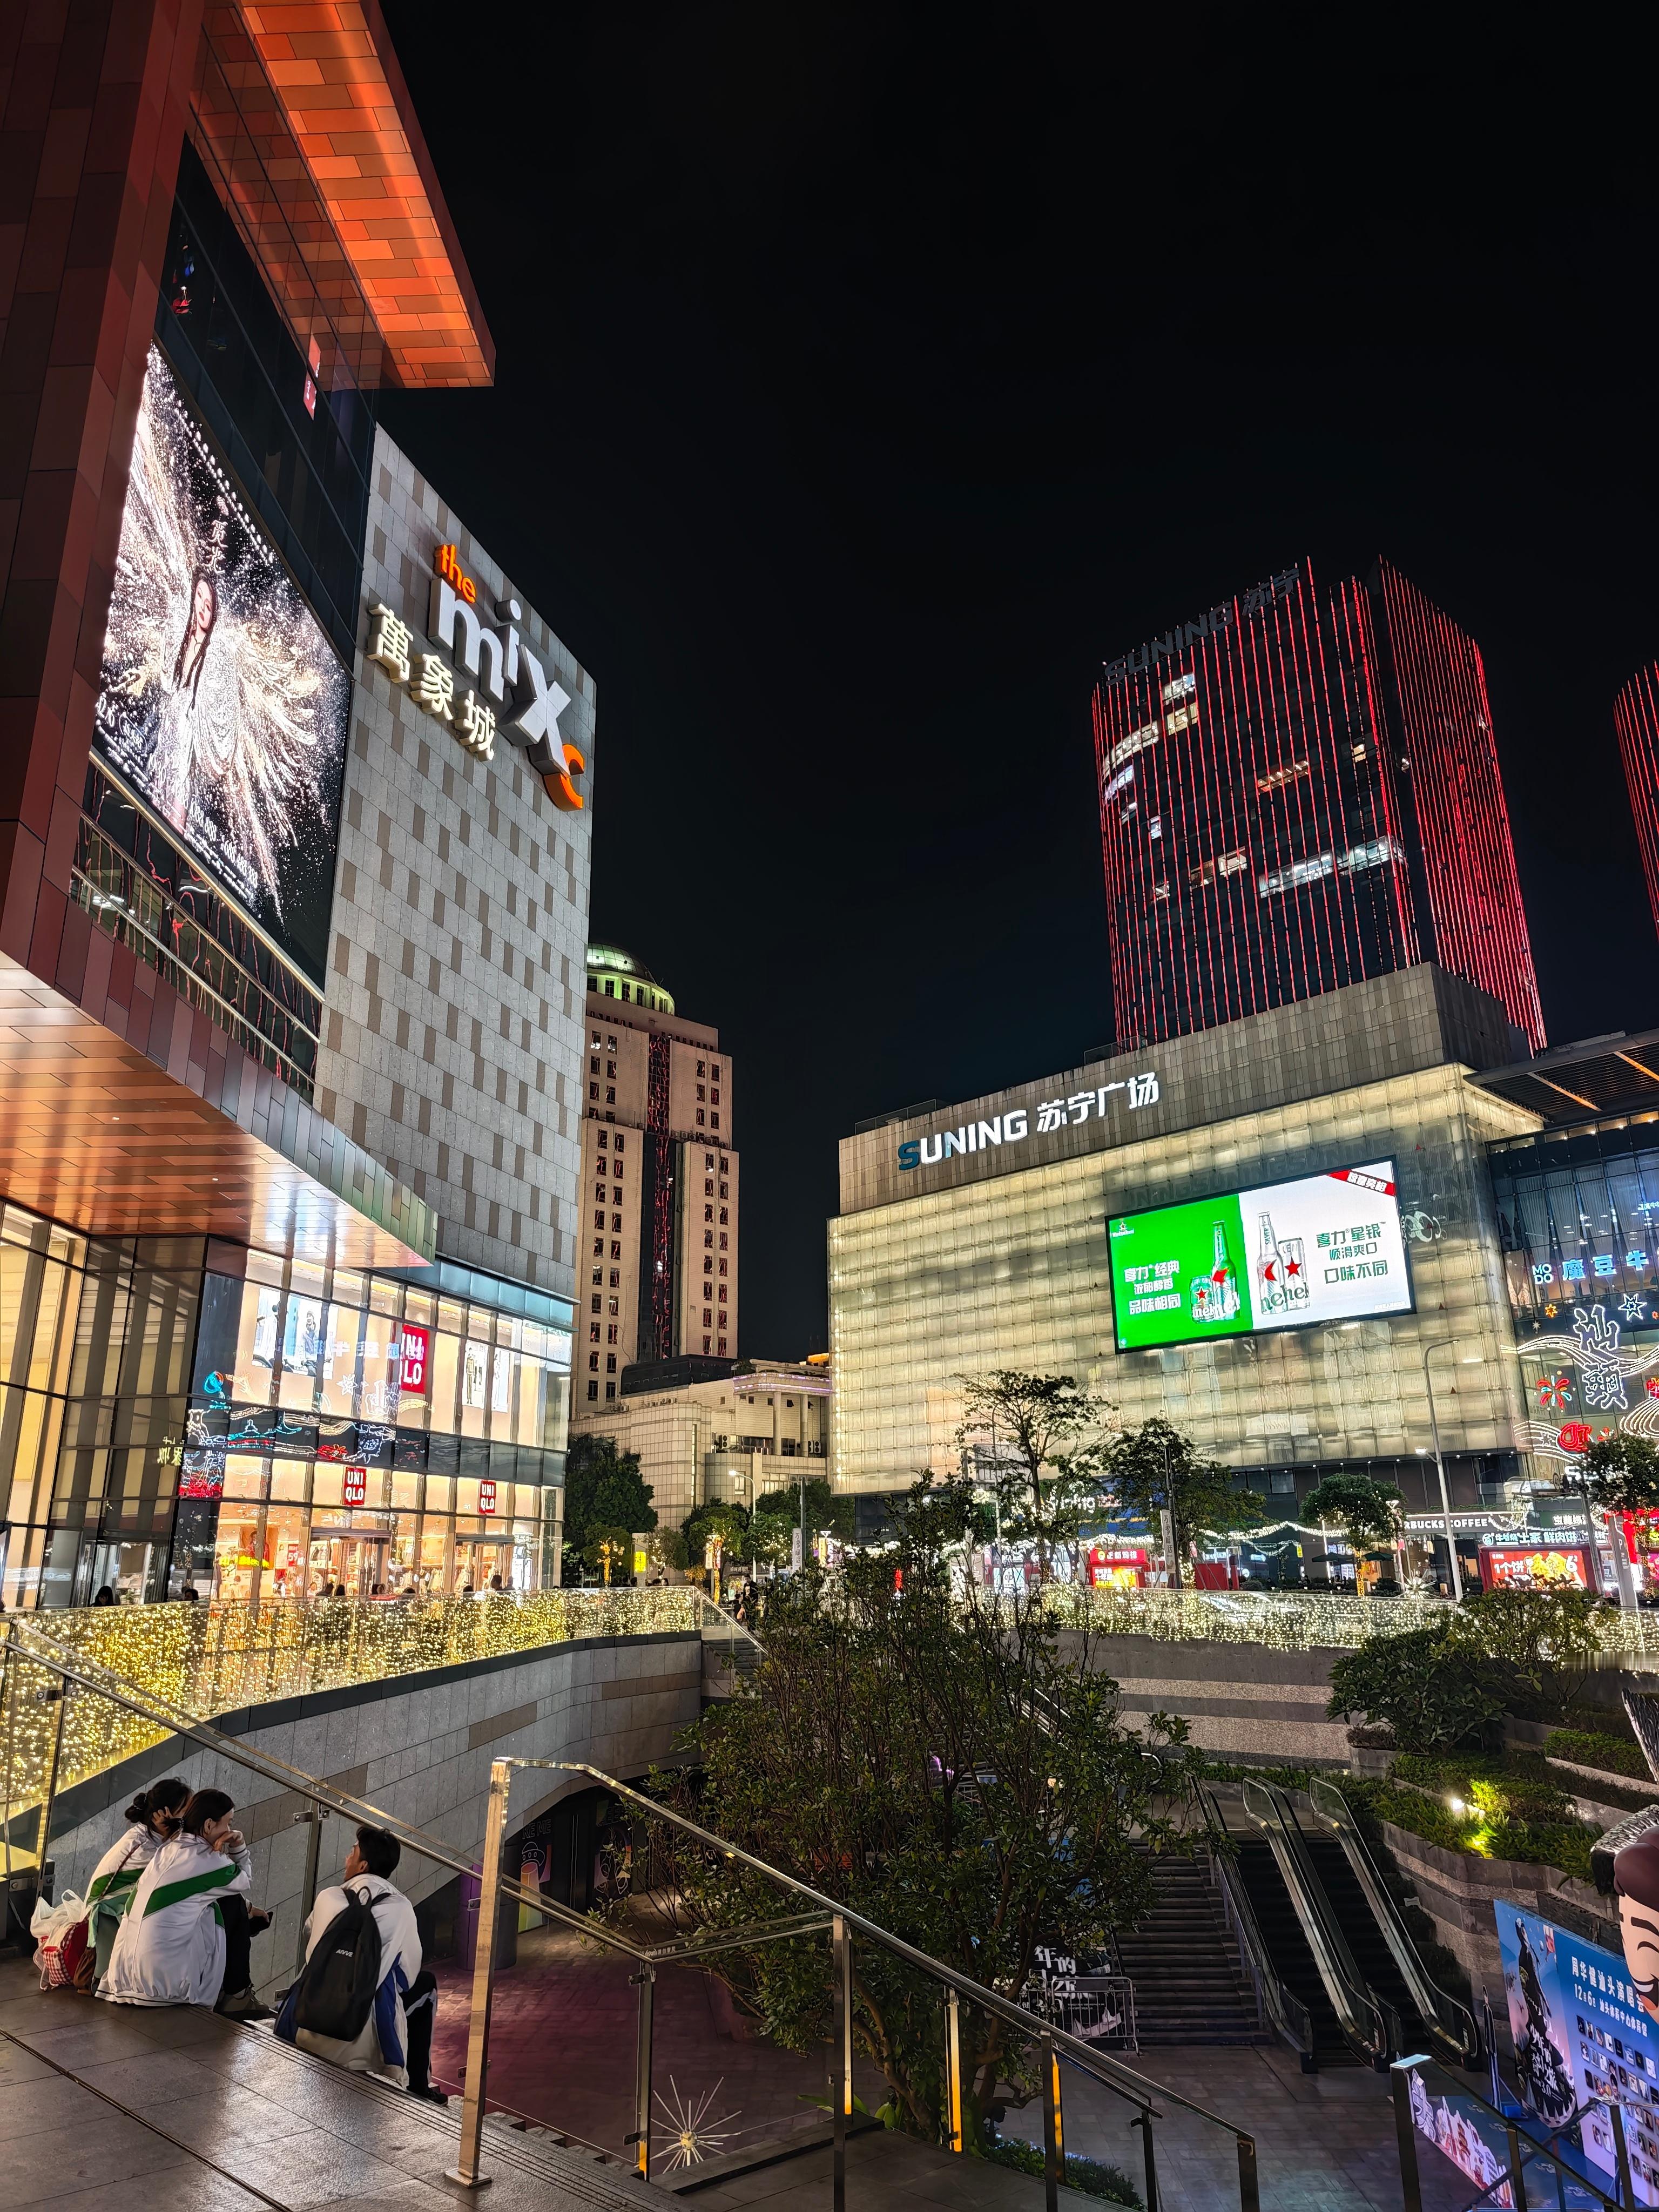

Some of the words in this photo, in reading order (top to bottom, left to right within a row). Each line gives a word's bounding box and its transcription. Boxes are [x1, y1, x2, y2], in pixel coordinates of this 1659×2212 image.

[434, 544, 477, 604] the
[1104, 601, 1234, 687] SUNING
[1242, 568, 1300, 616] 苏宁
[367, 602, 497, 762] 萬象城
[897, 1108, 1028, 1171] SUNING
[1036, 1071, 1161, 1133] 苏宁广场
[1329, 1242, 1378, 1261] 顺滑爽口
[1324, 1259, 1388, 1284] 口味不同
[1532, 1263, 1552, 1276] MO
[1562, 1246, 1659, 1281] 魔豆牛
[1534, 1273, 1554, 1285] DO
[1129, 1293, 1181, 1315] 品味相同
[347, 1472, 363, 1486] UNI
[345, 1486, 364, 1501] QLO
[481, 1484, 494, 1496] UNI
[480, 1496, 495, 1509] QLO
